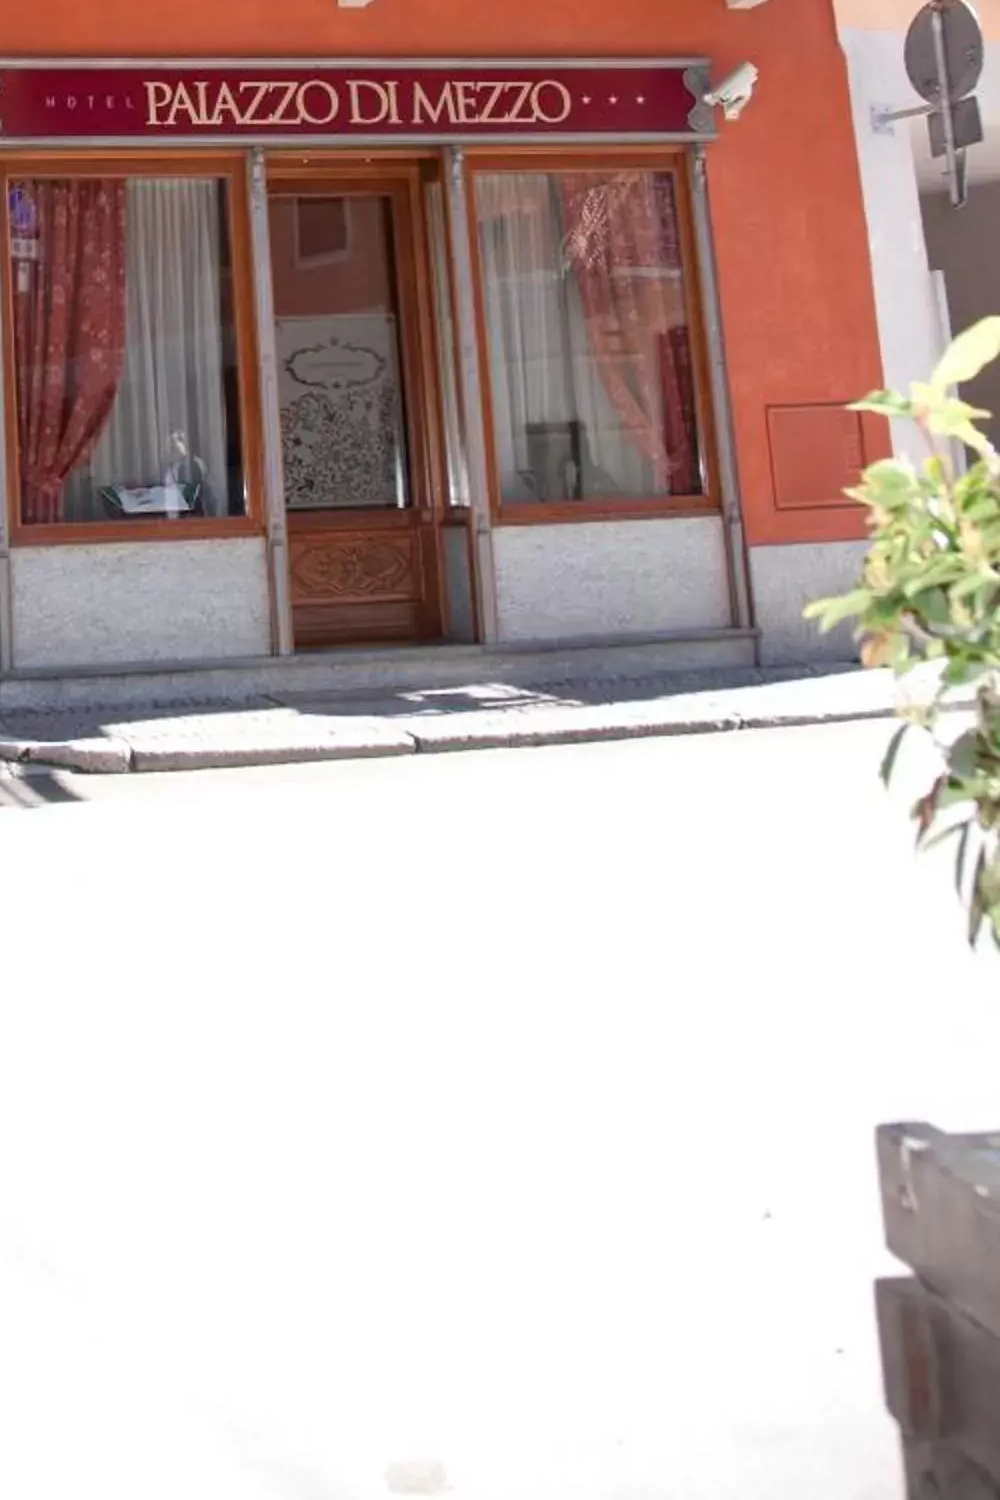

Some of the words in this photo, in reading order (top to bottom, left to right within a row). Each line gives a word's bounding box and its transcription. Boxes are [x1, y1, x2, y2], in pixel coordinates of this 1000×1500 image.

[45, 95, 136, 109] HOTEL
[143, 79, 340, 126] PALAZZO
[345, 80, 402, 124] DI
[411, 79, 572, 124] MEZZO
